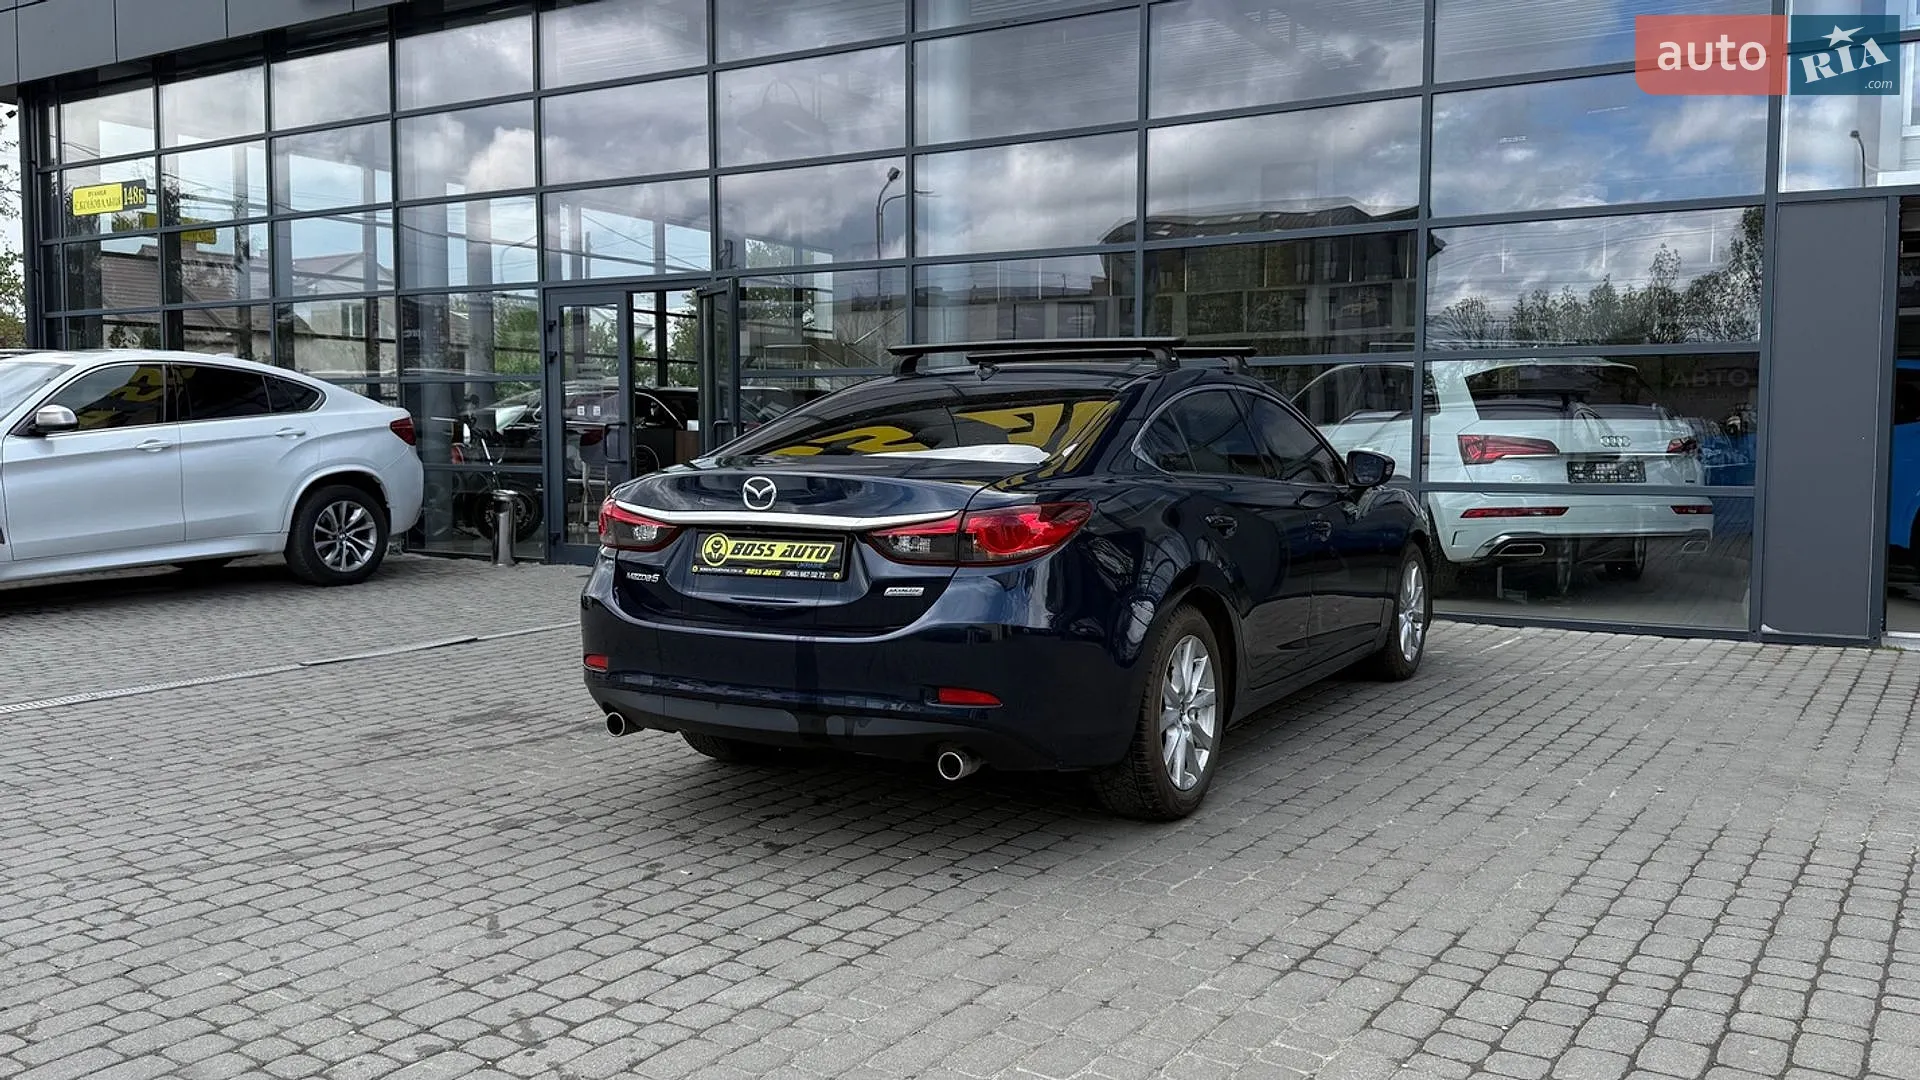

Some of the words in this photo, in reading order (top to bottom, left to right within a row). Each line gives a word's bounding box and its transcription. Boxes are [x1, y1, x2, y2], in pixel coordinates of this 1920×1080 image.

[1670, 368, 1750, 388] АВТО
[730, 542, 777, 557] BOSS
[778, 544, 832, 560] AUTO
